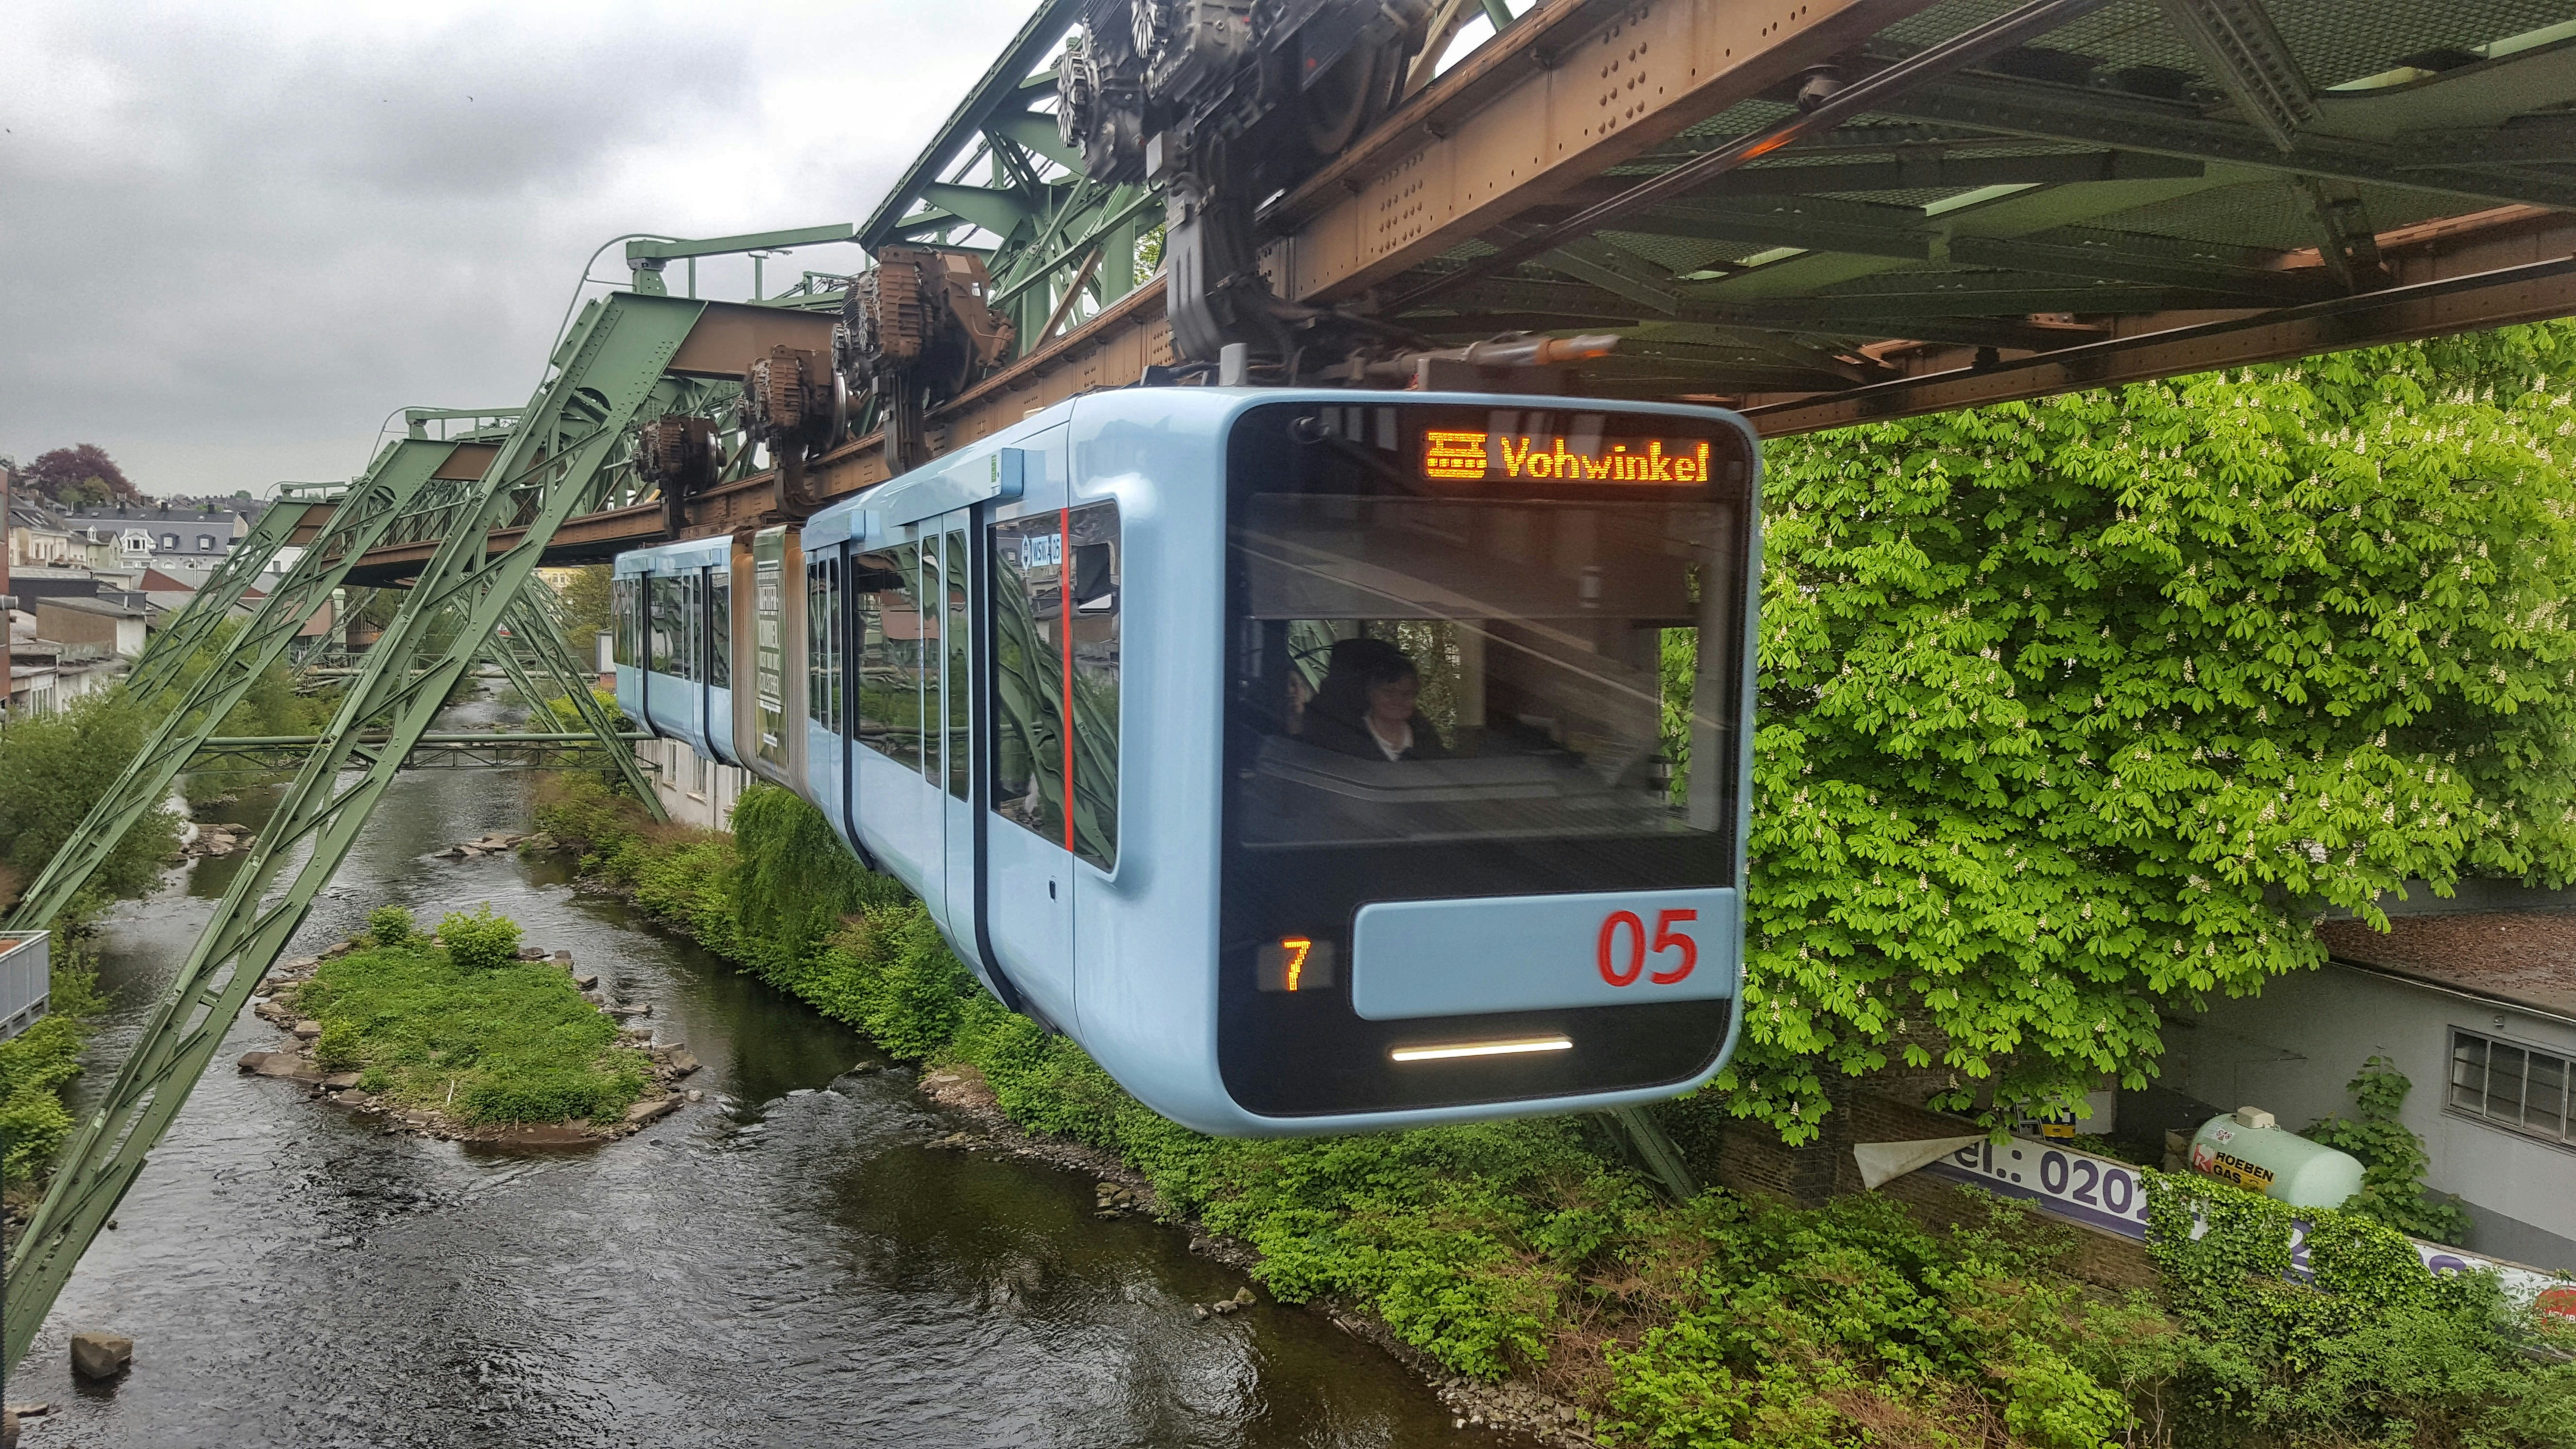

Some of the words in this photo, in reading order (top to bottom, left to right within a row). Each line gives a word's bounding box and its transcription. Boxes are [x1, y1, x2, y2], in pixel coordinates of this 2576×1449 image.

[1500, 436, 1710, 482] Vohwinkel
[1033, 541, 1047, 562] WSW
[1282, 938, 1312, 991] 7
[1596, 908, 1698, 987] 05
[1954, 1138, 2023, 1183] el.:
[2213, 1164, 2242, 1184] GAS
[2215, 1151, 2274, 1183] ROEBEN
